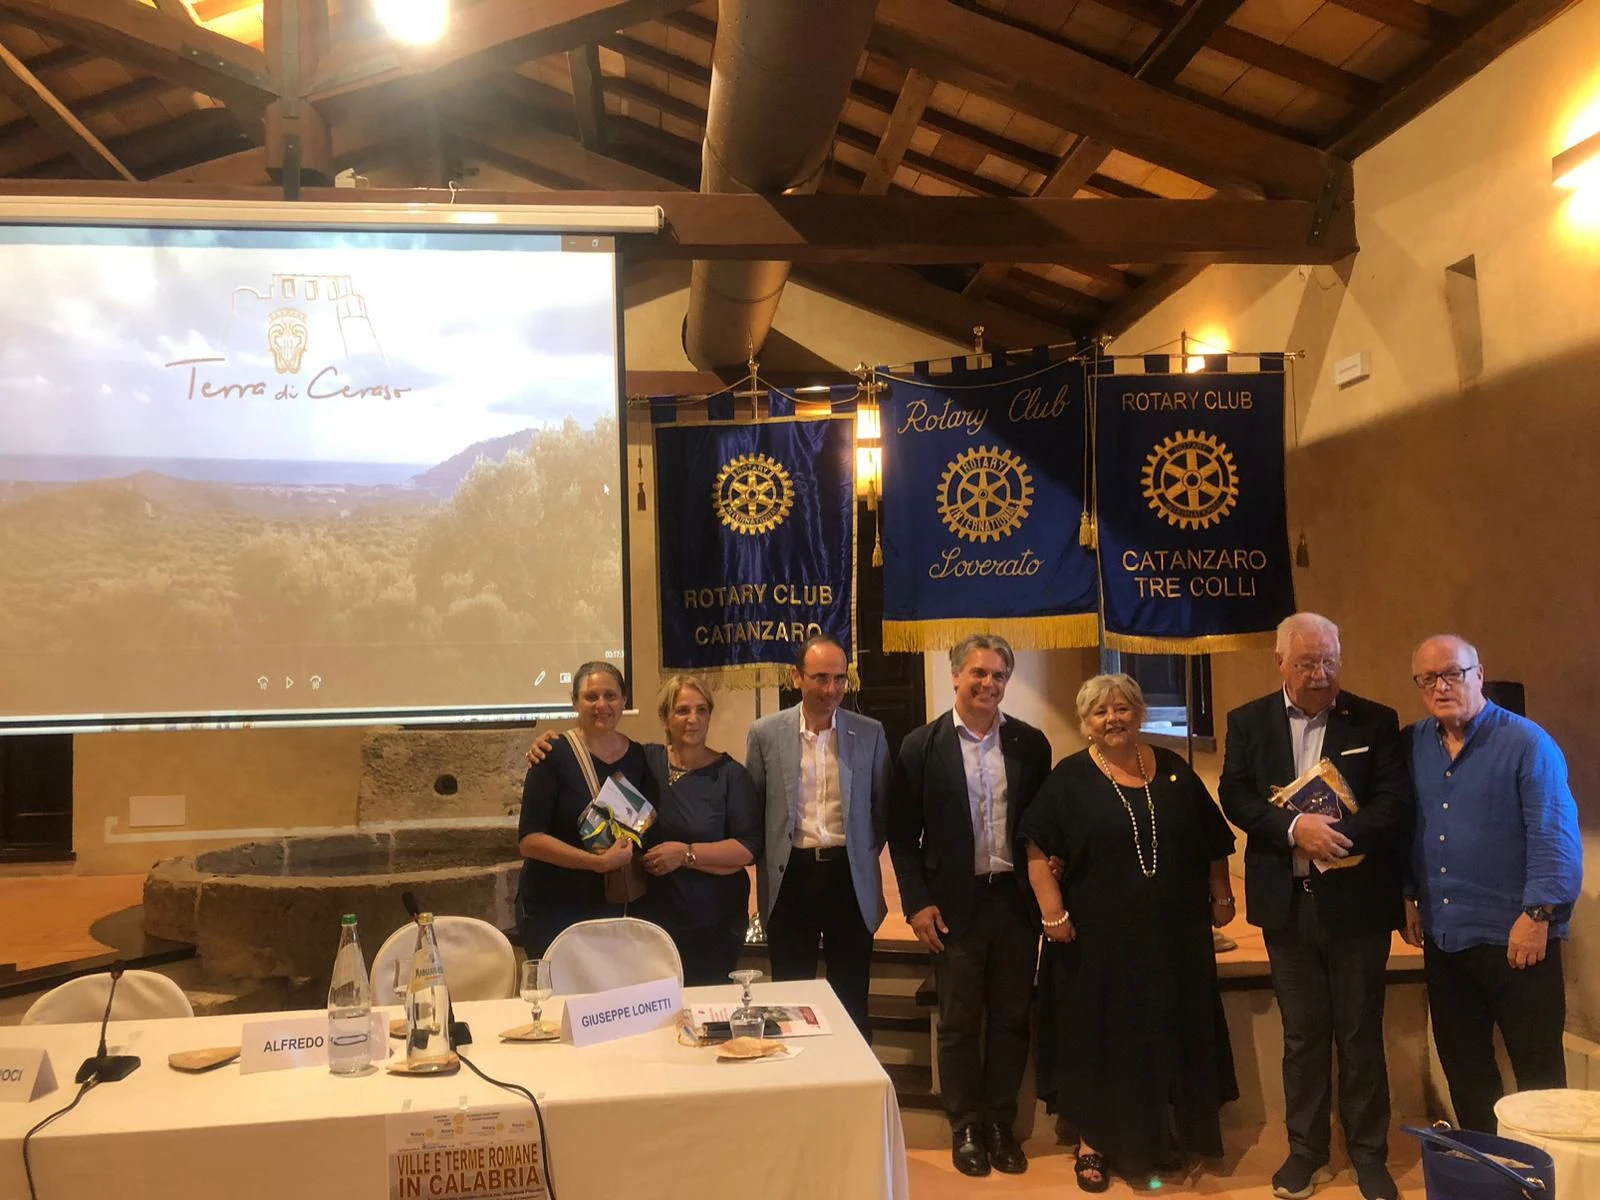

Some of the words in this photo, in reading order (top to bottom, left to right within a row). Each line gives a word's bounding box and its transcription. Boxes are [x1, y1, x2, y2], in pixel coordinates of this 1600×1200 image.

[165, 357, 267, 400] Terra
[274, 384, 299, 401] di
[897, 398, 990, 436] Rotary
[1008, 384, 1071, 423] Club
[1122, 391, 1199, 411] ROTARY
[1204, 390, 1254, 410] CLUB
[733, 463, 771, 476] ROTARY
[962, 456, 1008, 474] ROTARY
[950, 504, 1020, 533] INTERNATIONAL
[1121, 549, 1267, 572] CATANZARO
[684, 583, 768, 609] ROTARY
[773, 583, 834, 606] CLUB
[1134, 576, 1182, 599] TRE
[1189, 575, 1257, 598] COLLI
[694, 620, 823, 647] CATANZARO
[581, 1006, 631, 1028] GIUSEPPE
[632, 998, 672, 1017] LONETTI
[263, 1036, 325, 1053] ALFREDO
[0, 1068, 24, 1082] OCI
[397, 1152, 431, 1176] VILLE
[434, 1151, 442, 1173] E
[445, 1148, 485, 1171] TERME
[488, 1142, 539, 1168] ROMANE
[399, 1176, 421, 1198] IN
[428, 1165, 541, 1195] CALABRIA
